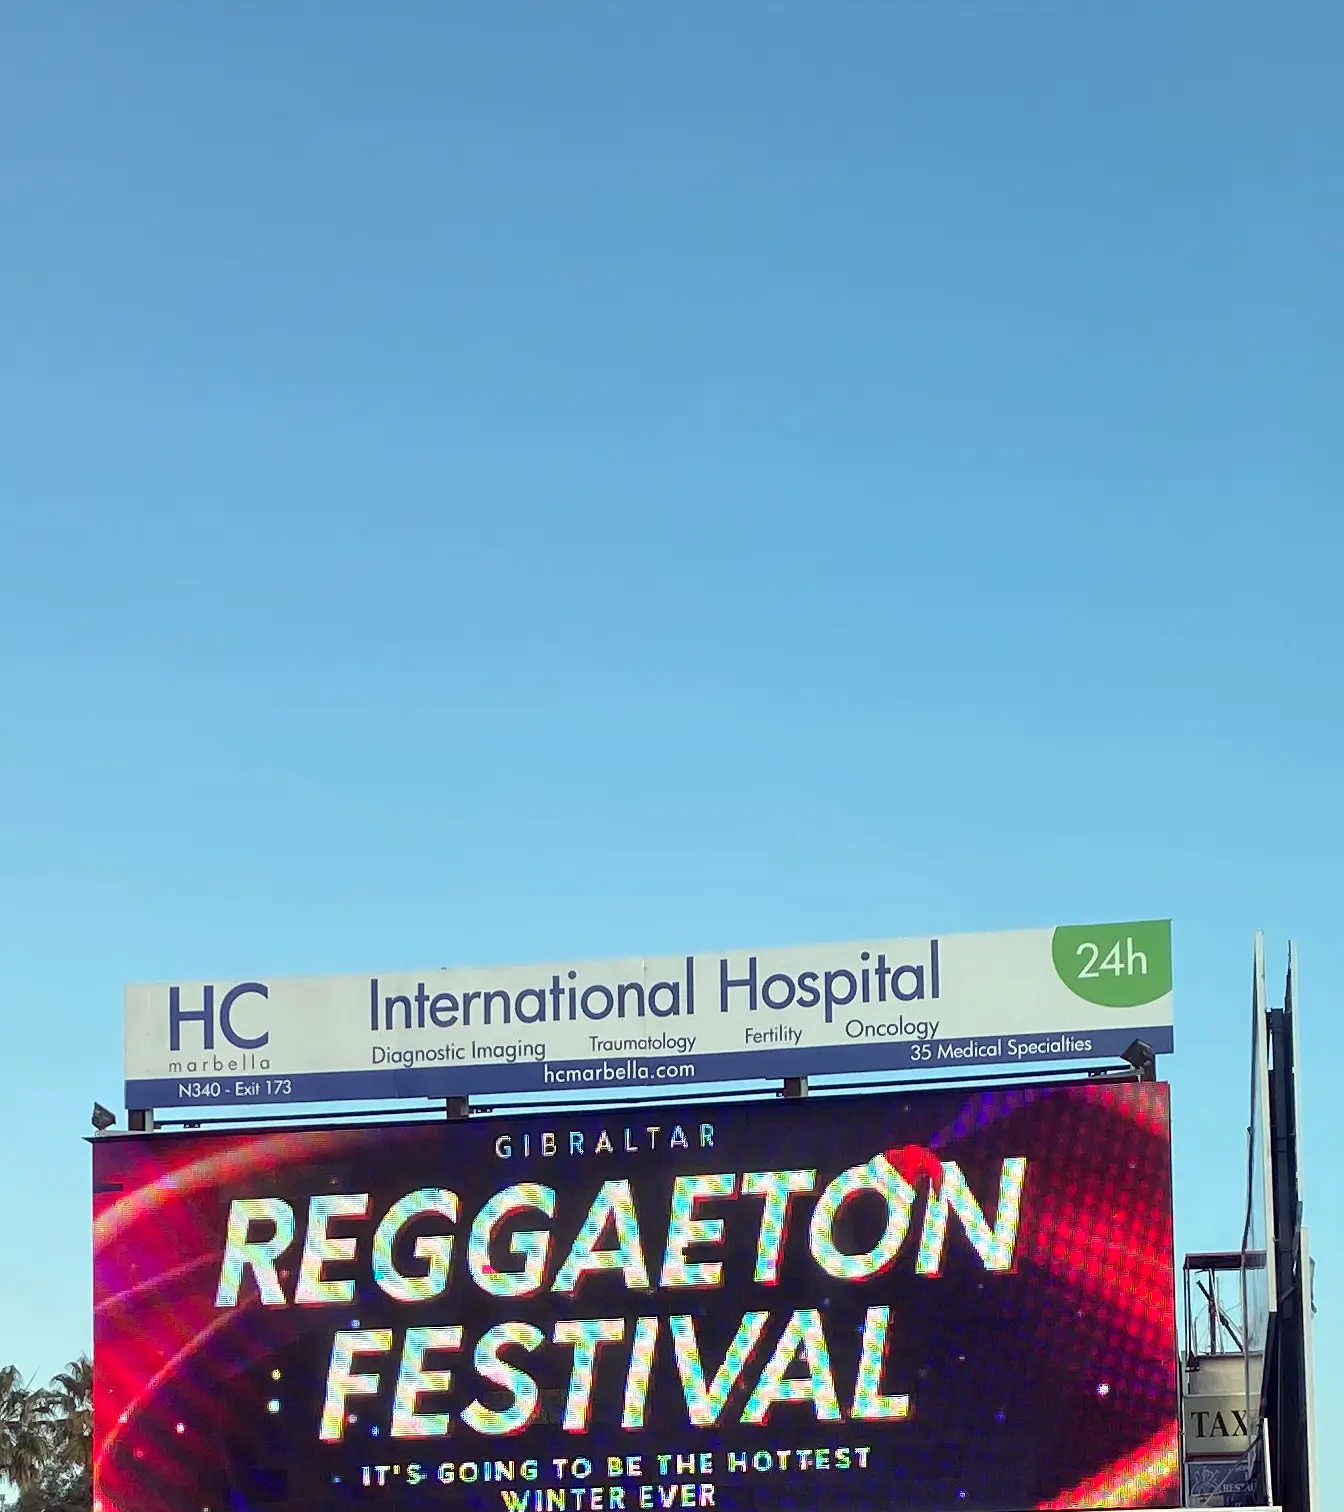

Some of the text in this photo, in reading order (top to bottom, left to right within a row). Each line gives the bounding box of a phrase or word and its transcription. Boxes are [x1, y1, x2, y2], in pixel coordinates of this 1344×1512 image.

[1076, 936, 1148, 979] 24h
[370, 939, 941, 1031] International Hospital
[168, 983, 269, 1051] HC
[372, 1015, 940, 1068] Diagnostic Imaging Traumatology Fertility Oncology
[910, 1035, 1092, 1062] 35 Medical Specialties
[168, 1055, 271, 1073] marbella
[544, 1061, 696, 1084] hcmarbella.com
[178, 1081, 221, 1098] N340
[235, 1081, 260, 1096] Exit
[265, 1079, 292, 1095] 173
[495, 1122, 715, 1159] GIBRALTAR
[214, 1153, 1027, 1308] REGGAETON
[319, 1305, 912, 1442] FESTIVAL
[1190, 1409, 1251, 1438] TAX
[362, 1446, 872, 1486] IT'S GOING TO BE THE HOTTEST
[500, 1484, 716, 1512] WINTER EVER
